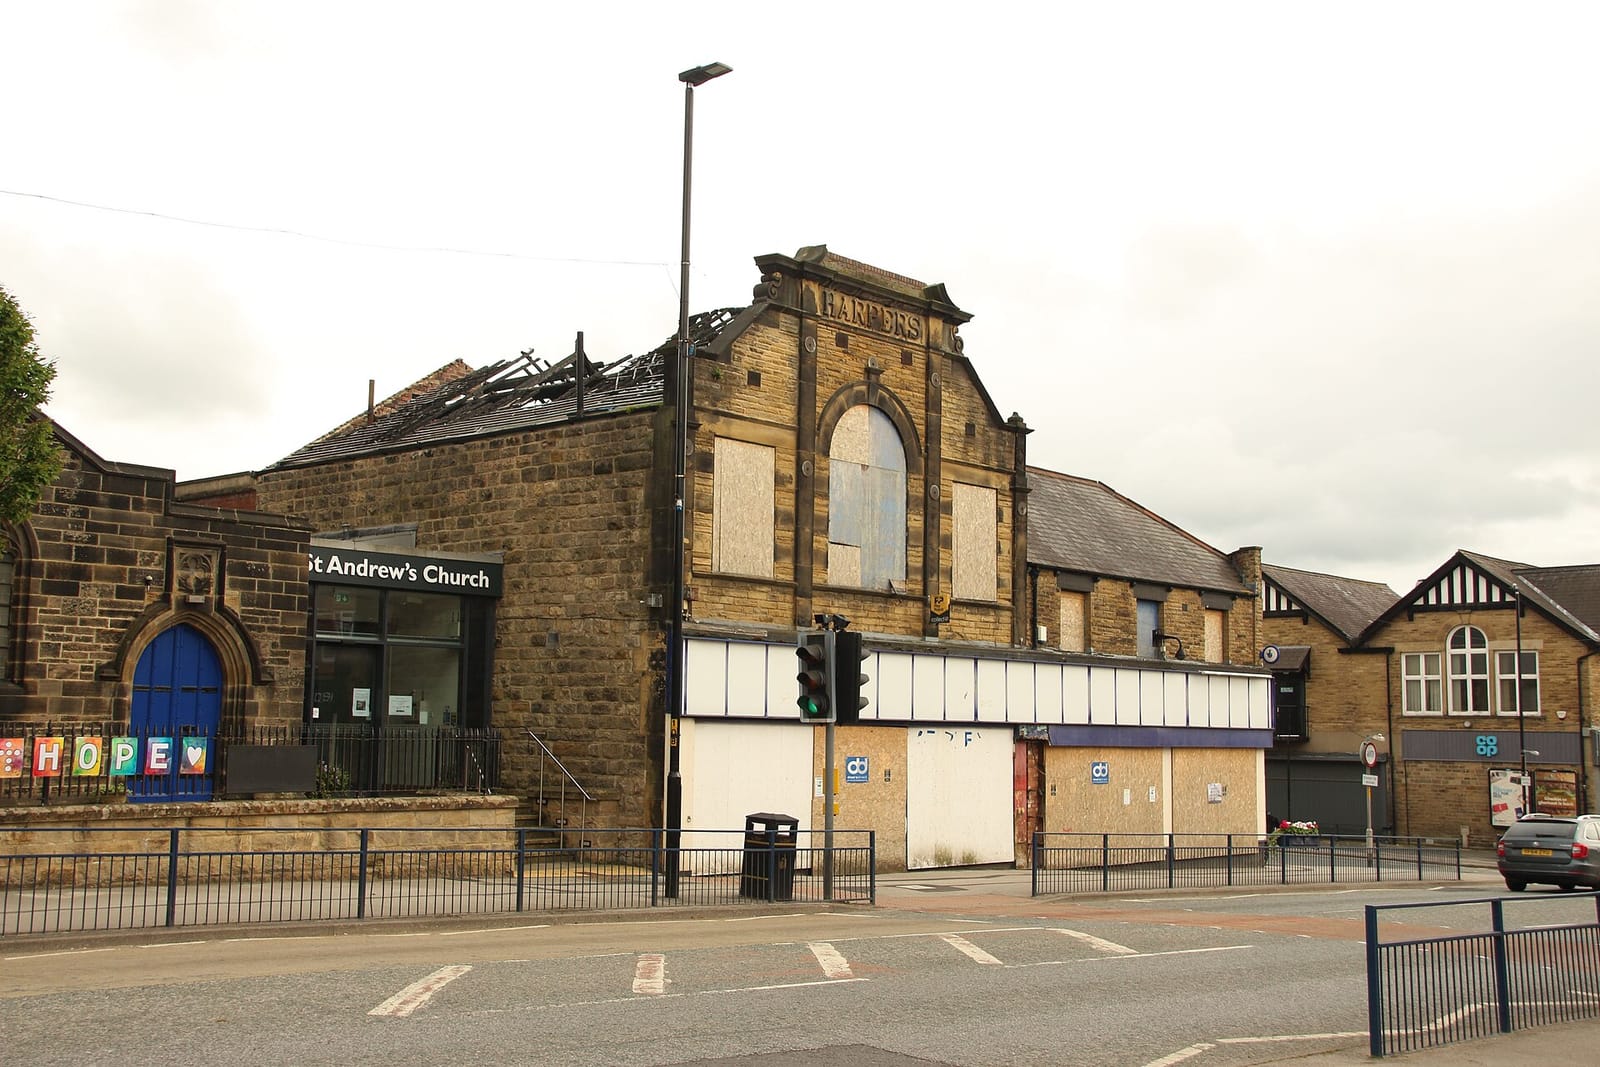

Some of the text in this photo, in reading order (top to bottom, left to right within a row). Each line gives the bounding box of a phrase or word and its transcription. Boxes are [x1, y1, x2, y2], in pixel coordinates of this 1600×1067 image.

[822, 288, 921, 339] HARPERS
[326, 555, 418, 582] Andrew's
[423, 564, 490, 588] Church
[38, 742, 170, 771] HOPE
